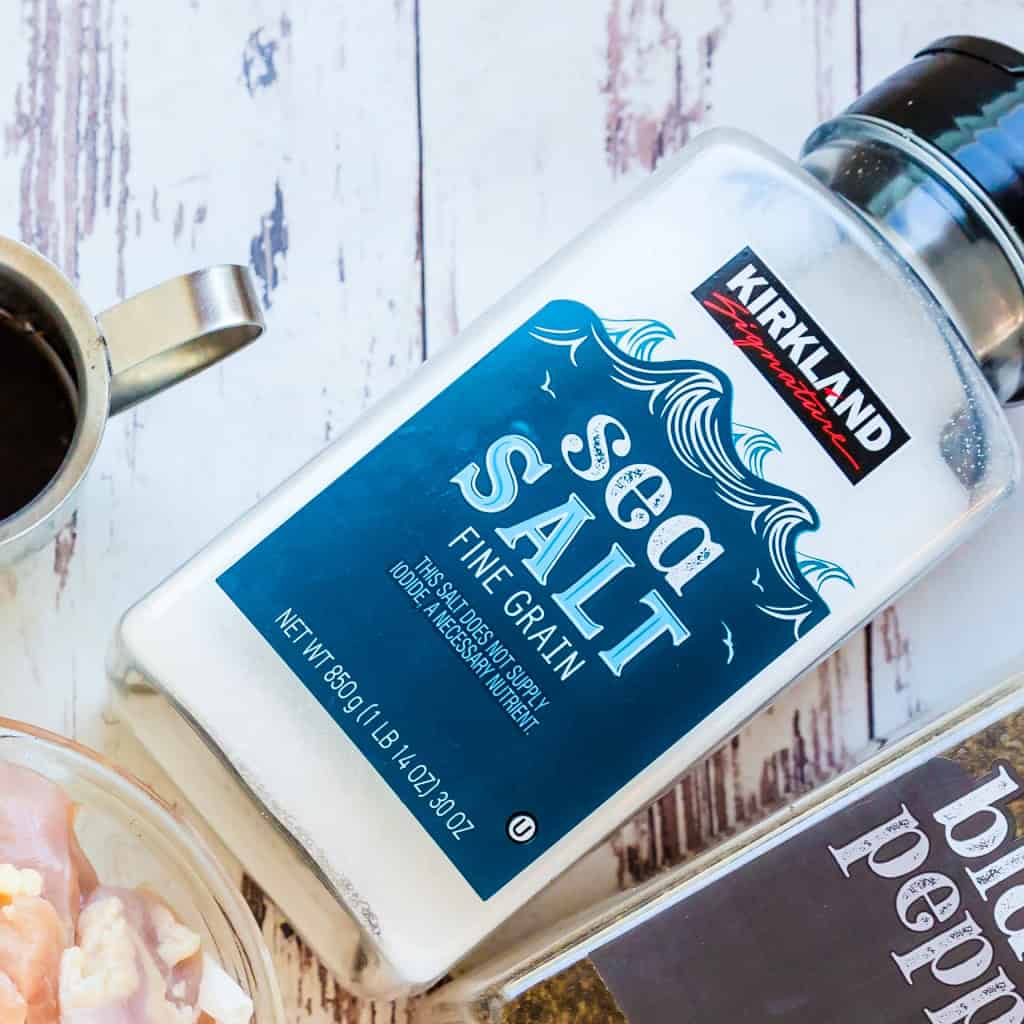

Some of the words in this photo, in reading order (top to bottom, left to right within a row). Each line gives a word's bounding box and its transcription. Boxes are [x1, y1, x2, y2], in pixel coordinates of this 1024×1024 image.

[702, 291, 860, 471] Signature
[726, 264, 892, 452] KIRKLAND
[450, 434, 691, 677] SALT
[561, 414, 725, 597] sea
[389, 560, 430, 608] IODIDE,
[424, 602, 440, 617] A
[433, 610, 495, 679] NECESSARY
[485, 673, 540, 735] NUTRIENT.
[414, 555, 444, 587] THIS
[436, 581, 469, 614] SALT
[459, 608, 493, 646] DOES
[486, 639, 516, 669] NOT
[506, 665, 550, 712] SUPPLY
[448, 526, 514, 595] FINE
[504, 590, 586, 681] GRAIN
[274, 607, 313, 644] NET
[302, 637, 335, 669] WT
[356, 703, 381, 727] (1
[371, 721, 400, 749] LB
[392, 744, 416, 770] 14
[407, 764, 441, 797] OZ)
[429, 791, 455, 817] 30
[446, 811, 475, 840] OZ
